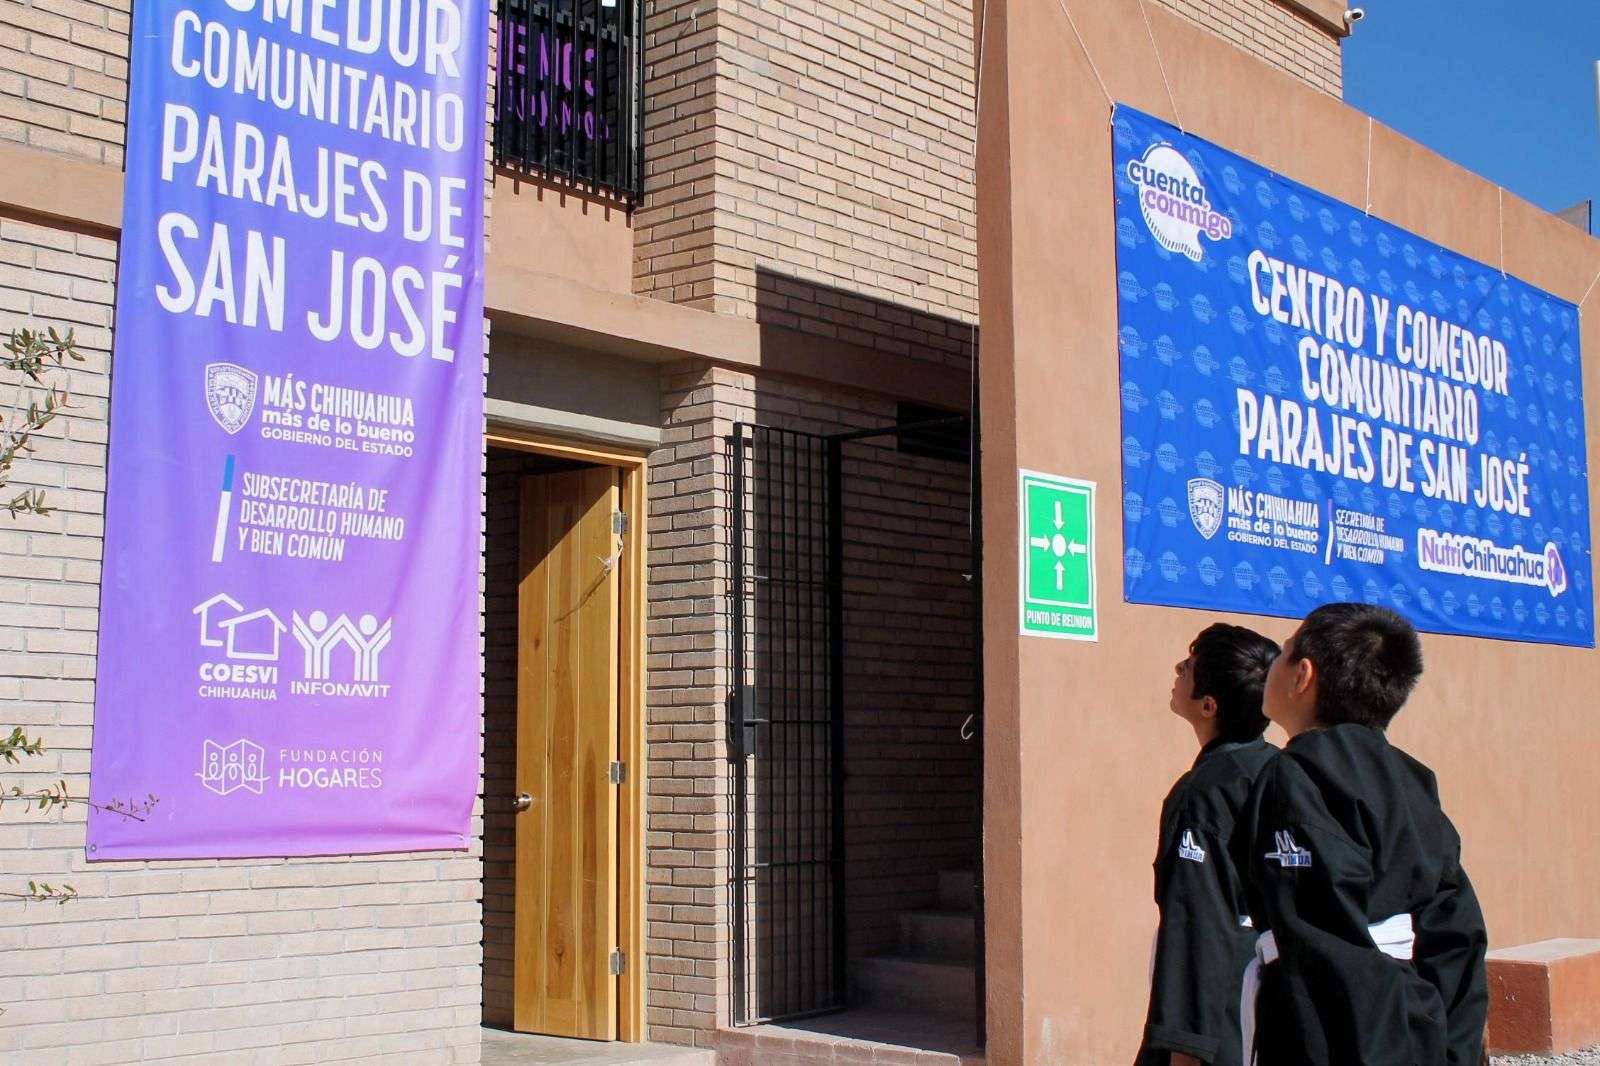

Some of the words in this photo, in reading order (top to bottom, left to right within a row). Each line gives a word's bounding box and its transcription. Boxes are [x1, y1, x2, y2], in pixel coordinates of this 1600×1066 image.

[171, 10, 464, 152] COMUNITARIO
[161, 102, 388, 233] PARAJES
[403, 169, 466, 249] DE
[1128, 161, 1204, 206] cuenta
[1144, 189, 1231, 238] conmigo
[155, 211, 286, 332] SAN
[307, 255, 463, 363] JOSÉ
[1247, 249, 1365, 348] CENTRO
[1370, 293, 1389, 356] Y
[1396, 304, 1509, 396] COMEDOR
[263, 373, 307, 410] MÁS
[311, 383, 415, 427] CHIHUAHUA
[1298, 336, 1479, 446] COMUNITARIO
[260, 427, 332, 447] GOBIERNO
[335, 439, 359, 451] DEL
[362, 441, 413, 458] ESTADO
[261, 409, 302, 428] más
[307, 415, 330, 431] de
[335, 418, 352, 435] lo
[356, 421, 415, 443] bueno
[1236, 388, 1376, 483] PARAJES
[1380, 427, 1414, 493] DE
[1419, 438, 1467, 504] SAN
[1473, 453, 1531, 518] JOSÉ
[242, 472, 364, 510] SUBSECRETARÍA
[367, 488, 388, 512] DE
[1228, 485, 1254, 517] MÁS
[1256, 493, 1320, 529] CHIHUAHUA
[240, 499, 338, 534] DESARROLLO
[340, 512, 405, 541] HUMANO
[1254, 519, 1271, 534] de
[1273, 521, 1284, 536] lo
[1286, 525, 1319, 542] bueno
[238, 526, 251, 551] Y
[251, 531, 283, 556] BIEN
[287, 532, 345, 561] COMÚN
[1227, 531, 1272, 547] GOBIERNO
[1273, 538, 1290, 550] DEL
[1291, 541, 1317, 554] ESTADO
[1421, 535, 1544, 580] NutriChihuahua
[1026, 609, 1050, 625] PUNTO
[1051, 611, 1062, 626] DE
[198, 685, 278, 701] CHIHUAHUA
[199, 662, 278, 685] COESVI
[290, 680, 391, 698] INFONAVIT
[279, 748, 383, 764] FUNDACIÓN
[278, 767, 383, 789] HOGARES
